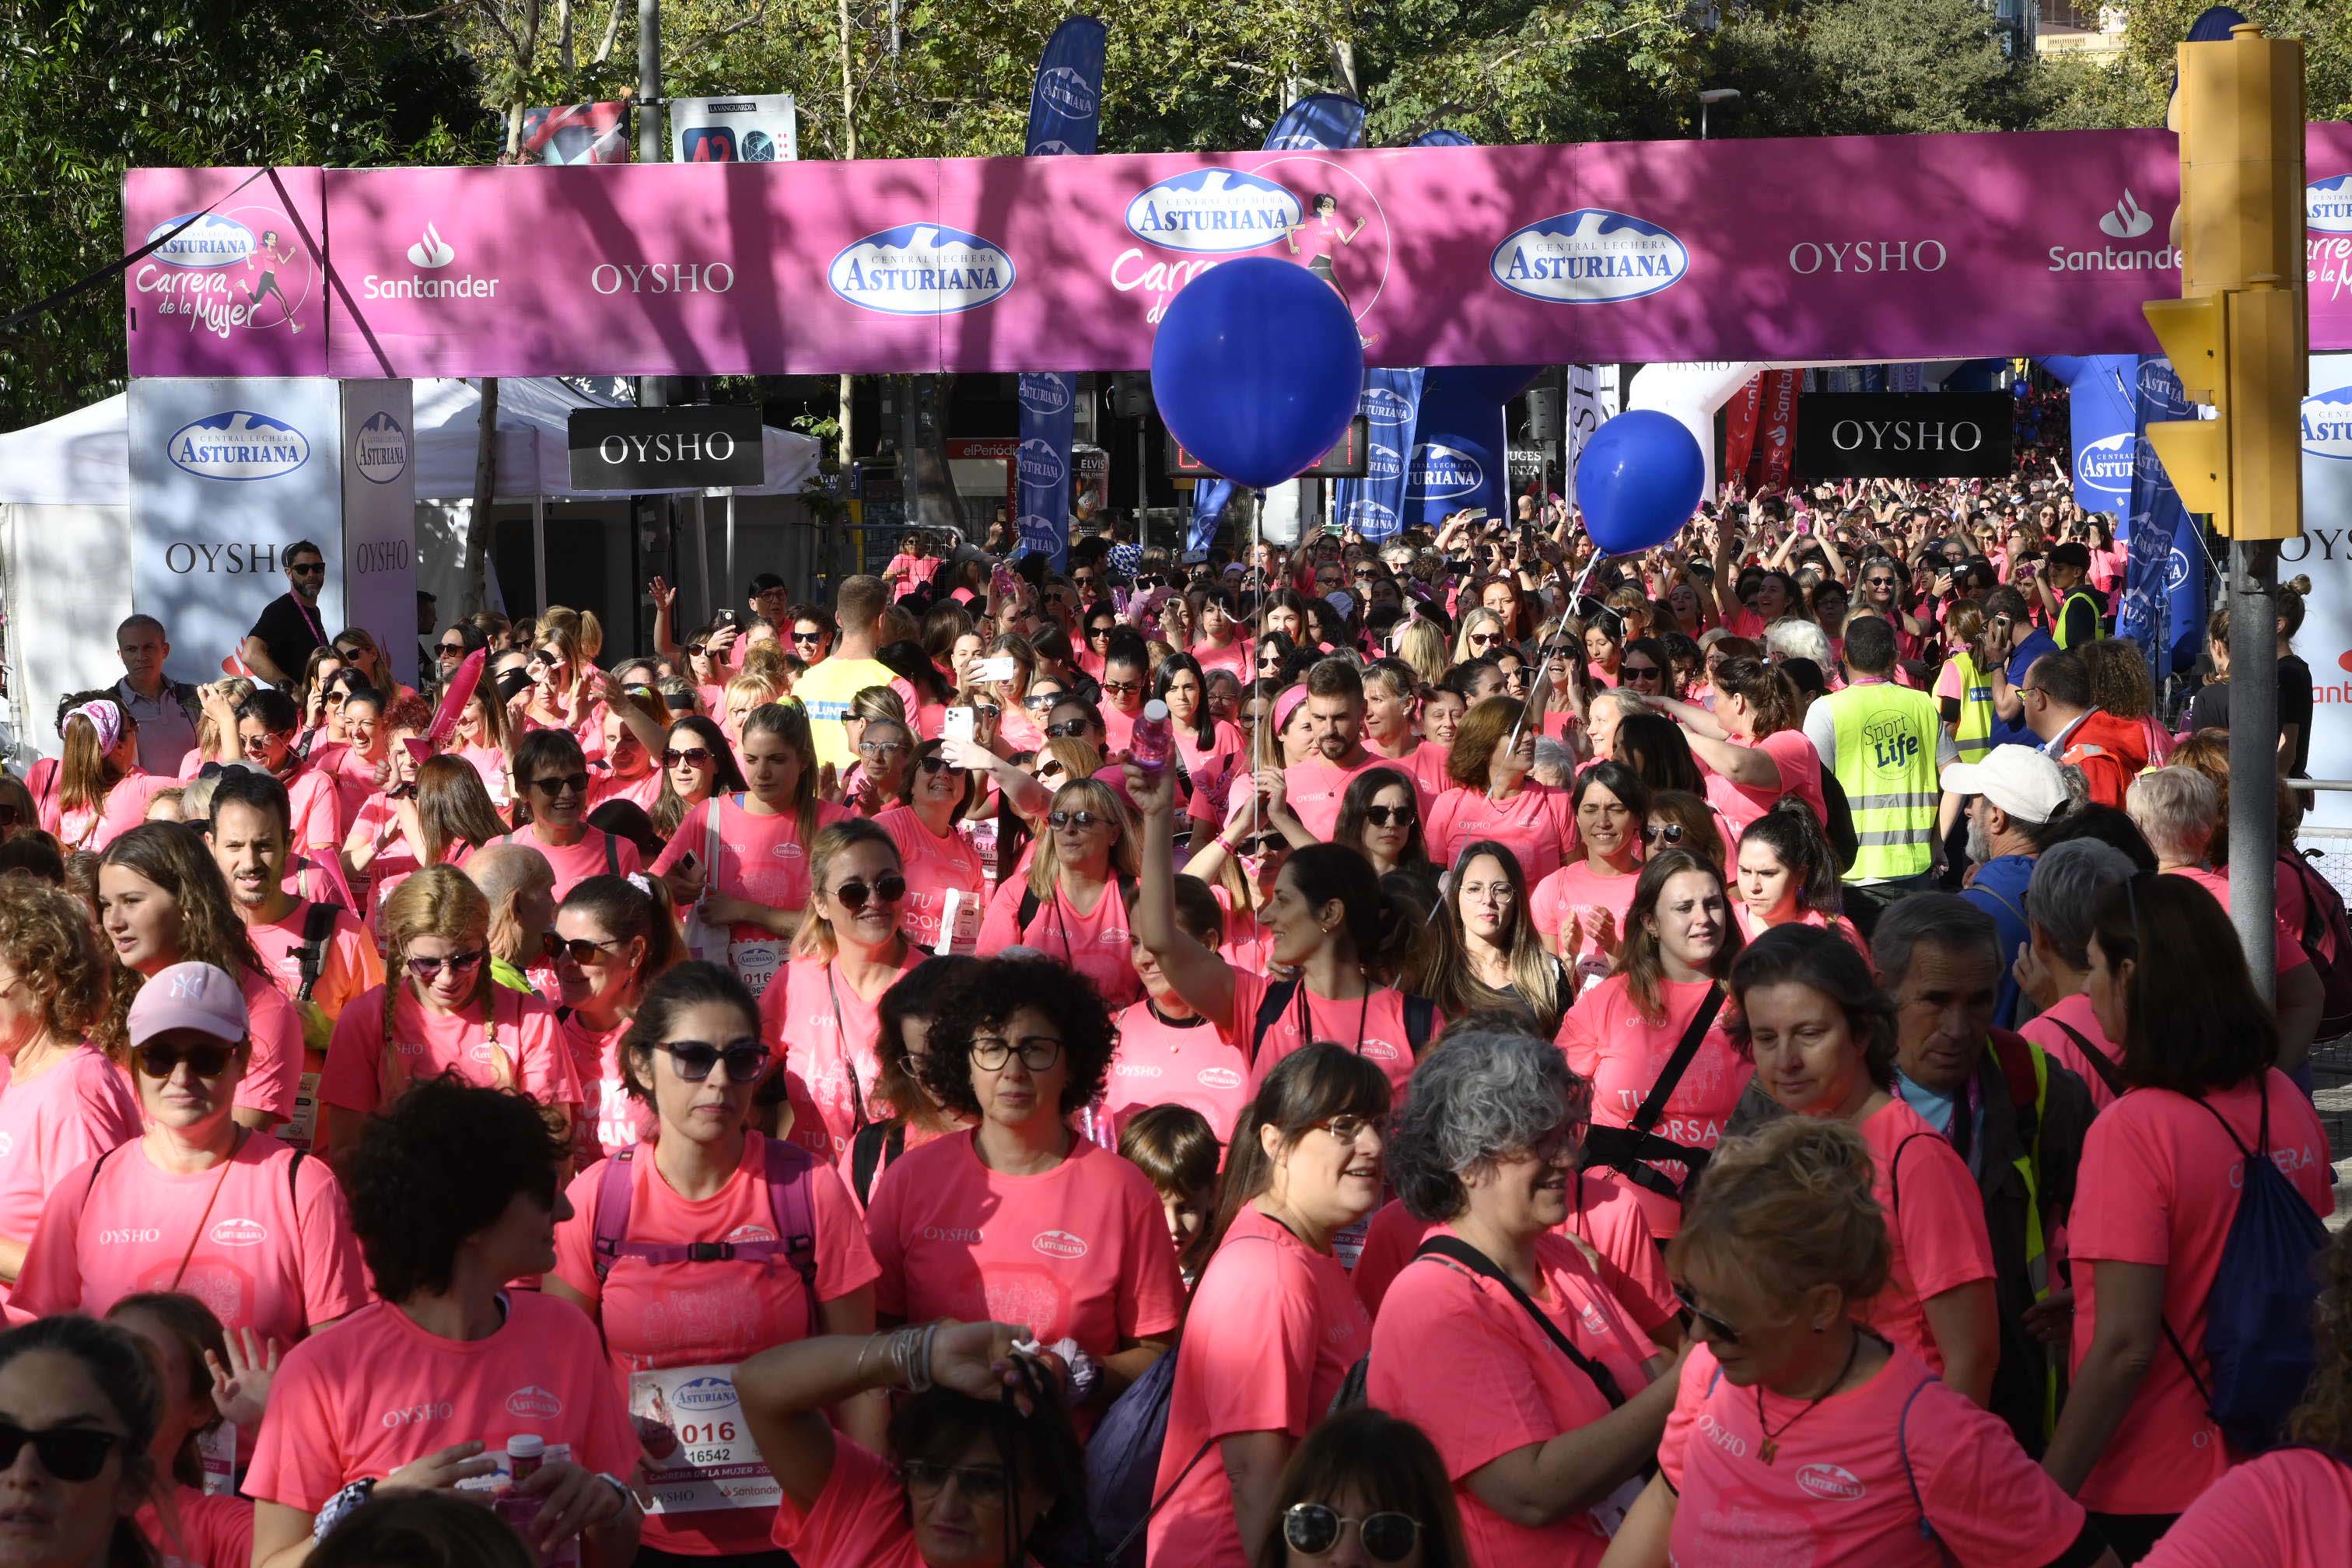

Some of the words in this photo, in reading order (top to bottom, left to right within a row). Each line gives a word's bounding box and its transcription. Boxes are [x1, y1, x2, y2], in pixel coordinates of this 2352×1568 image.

[1139, 199, 1289, 232] ASTURIANA
[871, 254, 930, 264] CENTRAL
[936, 254, 995, 263] LECHERA
[1536, 242, 1598, 252] CENTRAL
[1604, 240, 1667, 250] LECHERA
[1790, 240, 1946, 274] OYSHO
[2049, 243, 2183, 271] Santande
[843, 257, 1001, 292] ASTURIANA
[1506, 246, 1673, 280] ASTURIANA
[136, 264, 227, 292] Carrera
[363, 275, 499, 299] Santander
[591, 262, 734, 295] OYSHO
[159, 295, 177, 314] de
[179, 292, 191, 314] la
[189, 289, 262, 339] Mujer
[1774, 369, 1794, 423] Santa
[179, 437, 299, 463] ASTURIANA
[600, 432, 734, 465] OYSHO
[963, 443, 1018, 456] elPeriódi
[1832, 420, 1983, 453] OYSHO
[359, 440, 404, 467] ASTURIANA
[1081, 459, 1104, 469] ELVIS
[357, 539, 408, 574] OYSHO
[2313, 684, 2352, 704] ant
[1864, 714, 1908, 746] Sport
[1875, 733, 1919, 768] Life
[911, 892, 933, 909] TU
[744, 972, 772, 984] 016
[1115, 1064, 1161, 1078] OYSHO
[100, 1227, 160, 1245] OYSHO
[214, 1227, 263, 1241] ASTURIANA
[923, 1226, 983, 1243] OYSHO
[1035, 1237, 1083, 1254] ASTURIANA
[677, 1389, 737, 1405] ASTURIANA
[383, 1402, 454, 1428] OYSHO
[681, 1420, 736, 1444] 016
[689, 1448, 731, 1463] 16542
[1756, 1437, 1780, 1466] M
[709, 1468, 720, 1477] LA
[722, 1467, 753, 1476] MUJER
